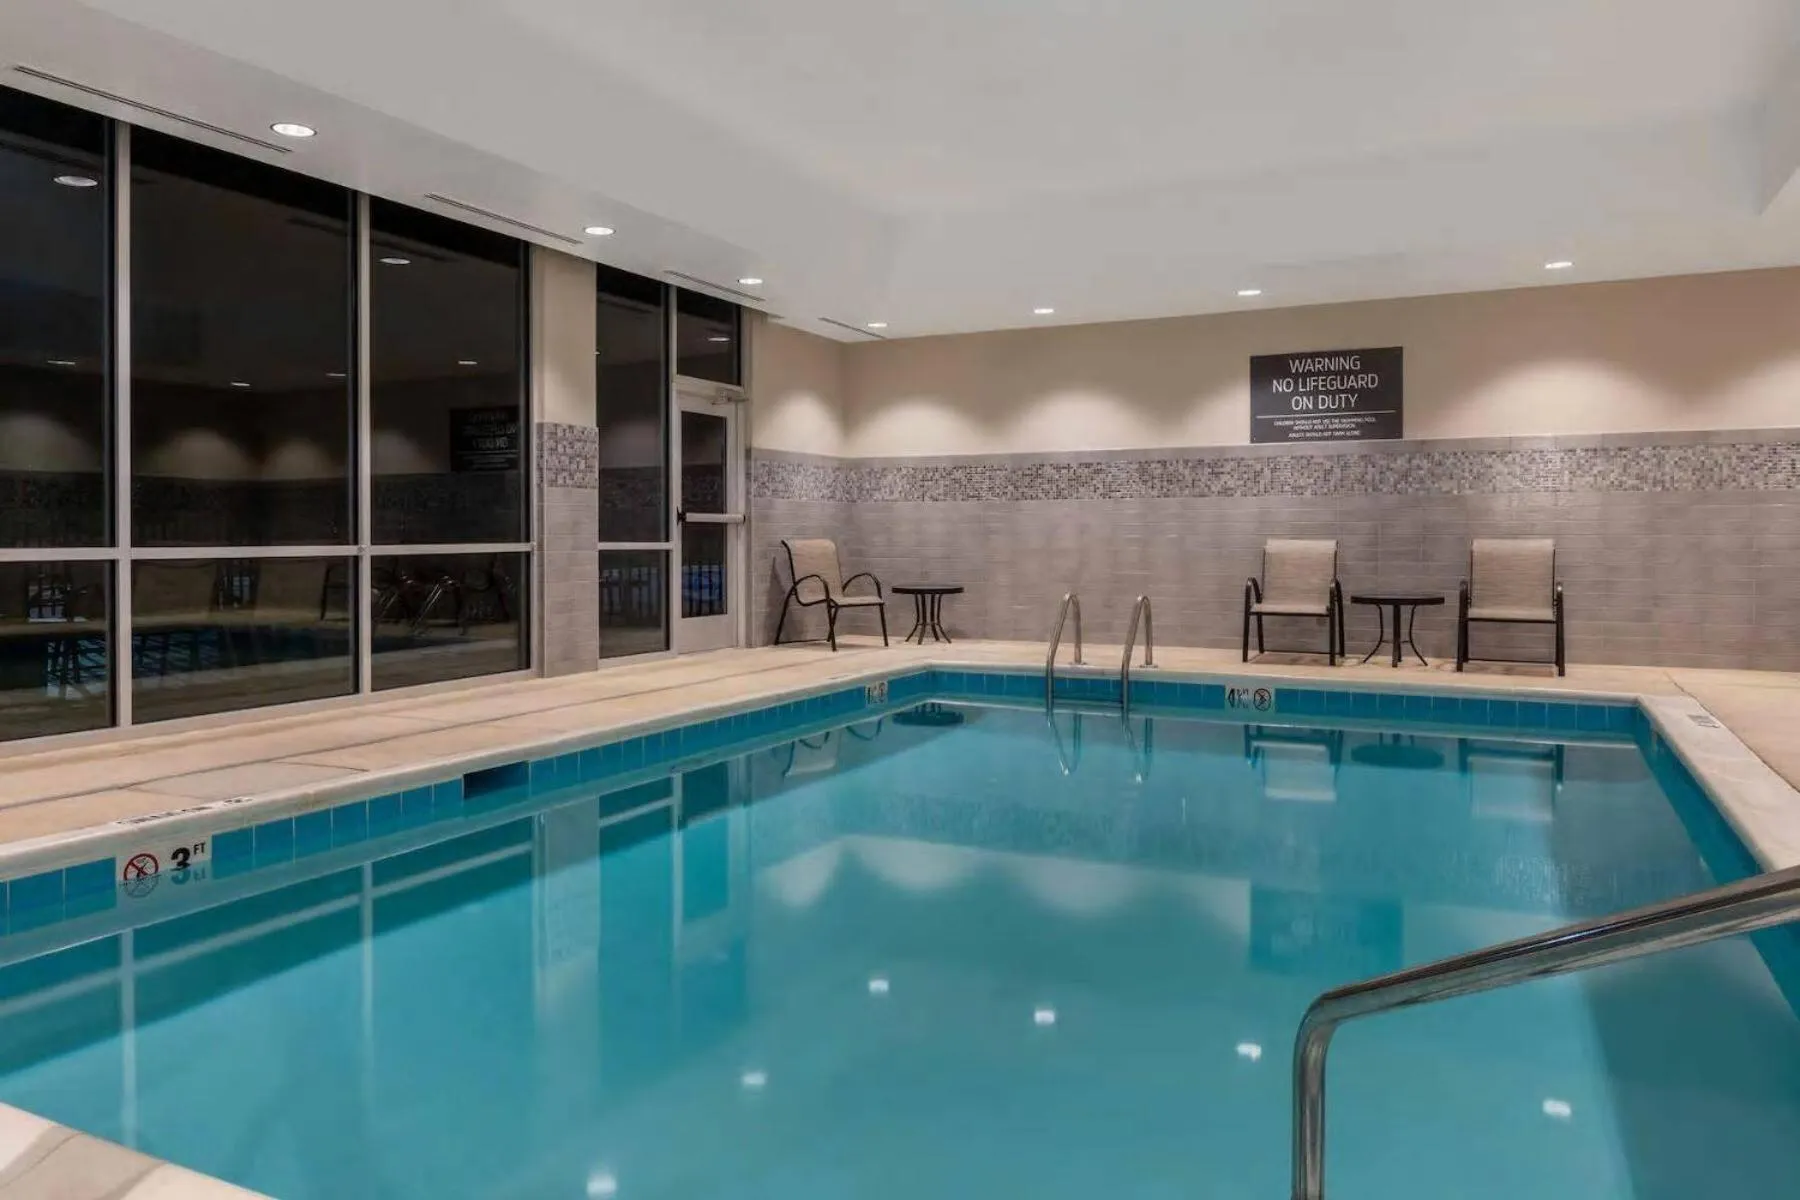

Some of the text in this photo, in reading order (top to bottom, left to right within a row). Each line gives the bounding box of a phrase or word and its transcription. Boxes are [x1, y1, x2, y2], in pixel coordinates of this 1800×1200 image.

[1289, 355, 1361, 373] WARNING
[1272, 374, 1379, 393] NO LIFEGUARD
[1291, 394, 1358, 410] ON DUTY
[170, 842, 206, 871] 3 FT
